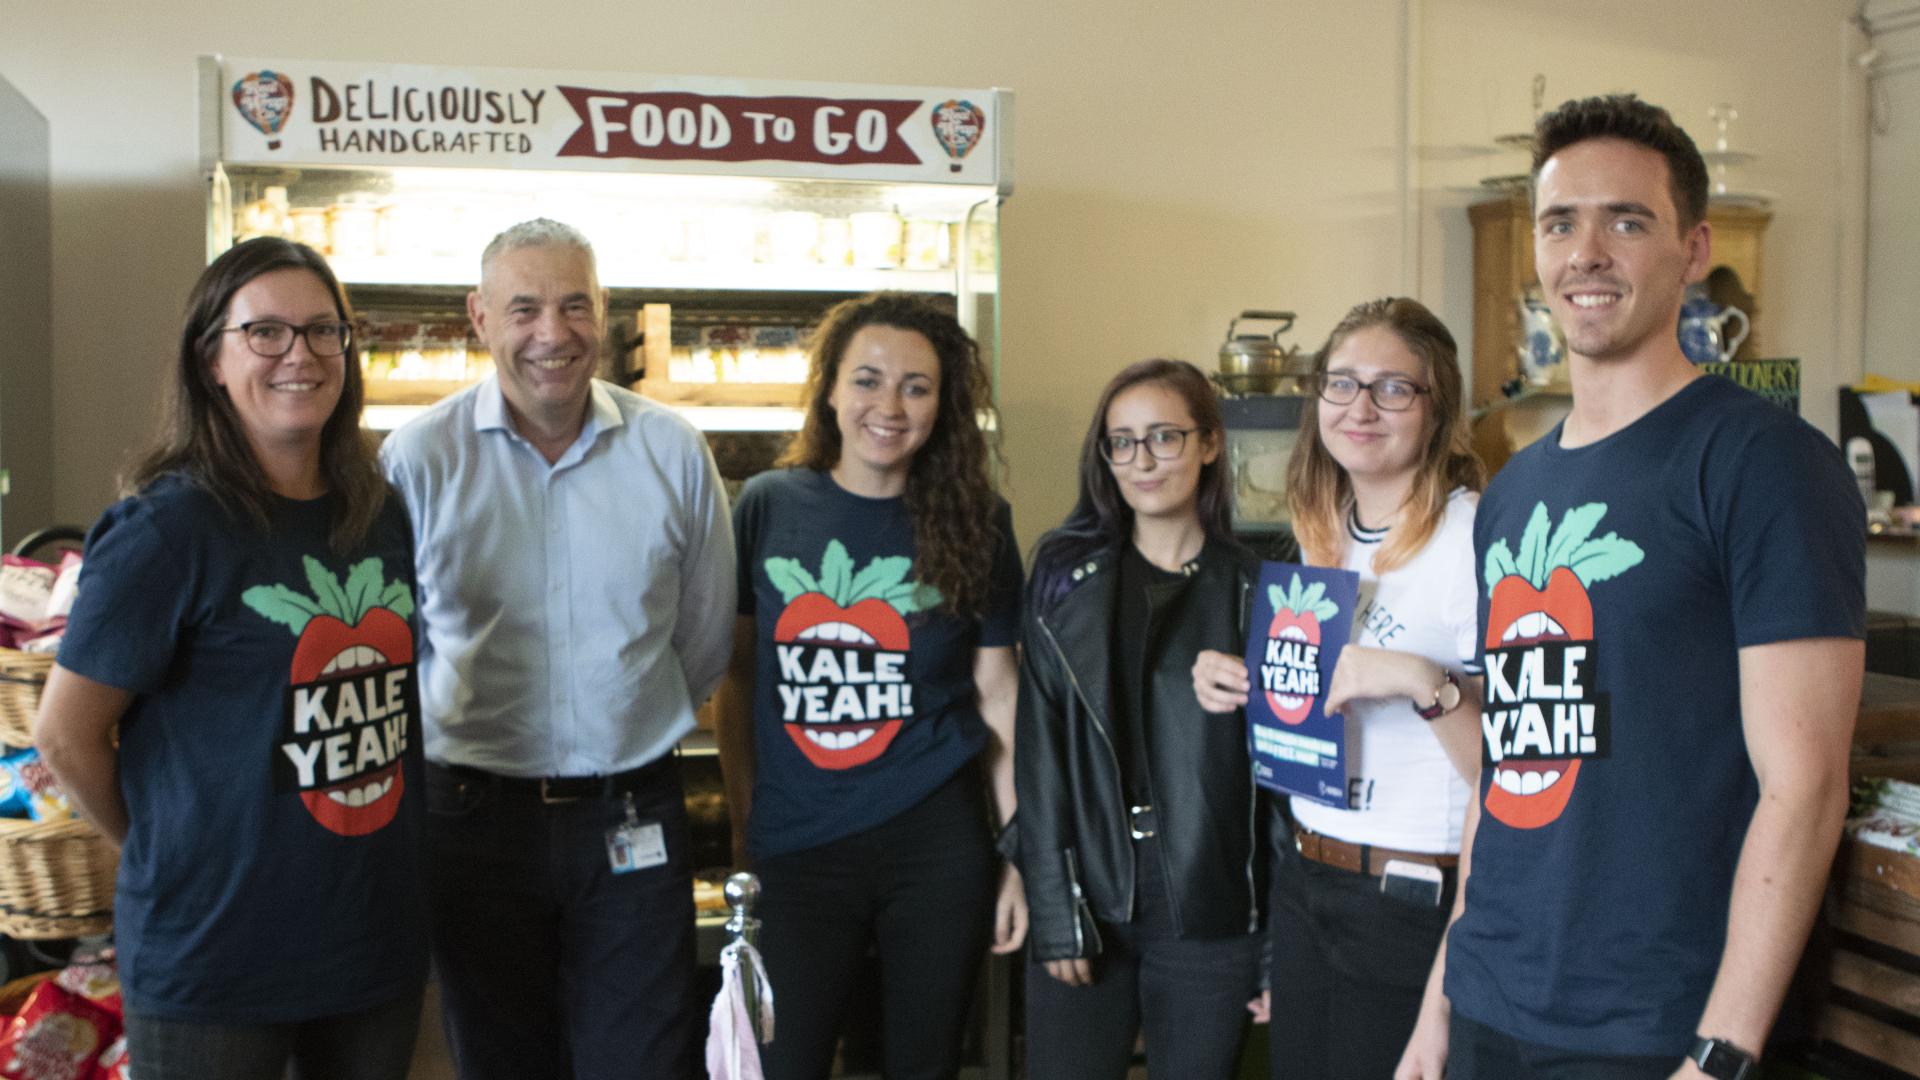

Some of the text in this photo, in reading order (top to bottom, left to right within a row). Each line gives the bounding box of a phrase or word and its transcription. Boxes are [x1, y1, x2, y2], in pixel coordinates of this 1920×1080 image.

[309, 76, 546, 124] DELICIOUSLY
[319, 127, 532, 154] HANDCRAFTED
[587, 96, 731, 153] FOOD
[742, 111, 796, 144] TO
[813, 105, 888, 155] GO
[776, 644, 906, 685] KALE
[1266, 639, 1319, 672] KALE
[1261, 664, 1320, 695] YEAH!
[293, 668, 409, 734] KALE
[777, 683, 914, 723] YEAH!
[281, 712, 409, 788] YEAH!
